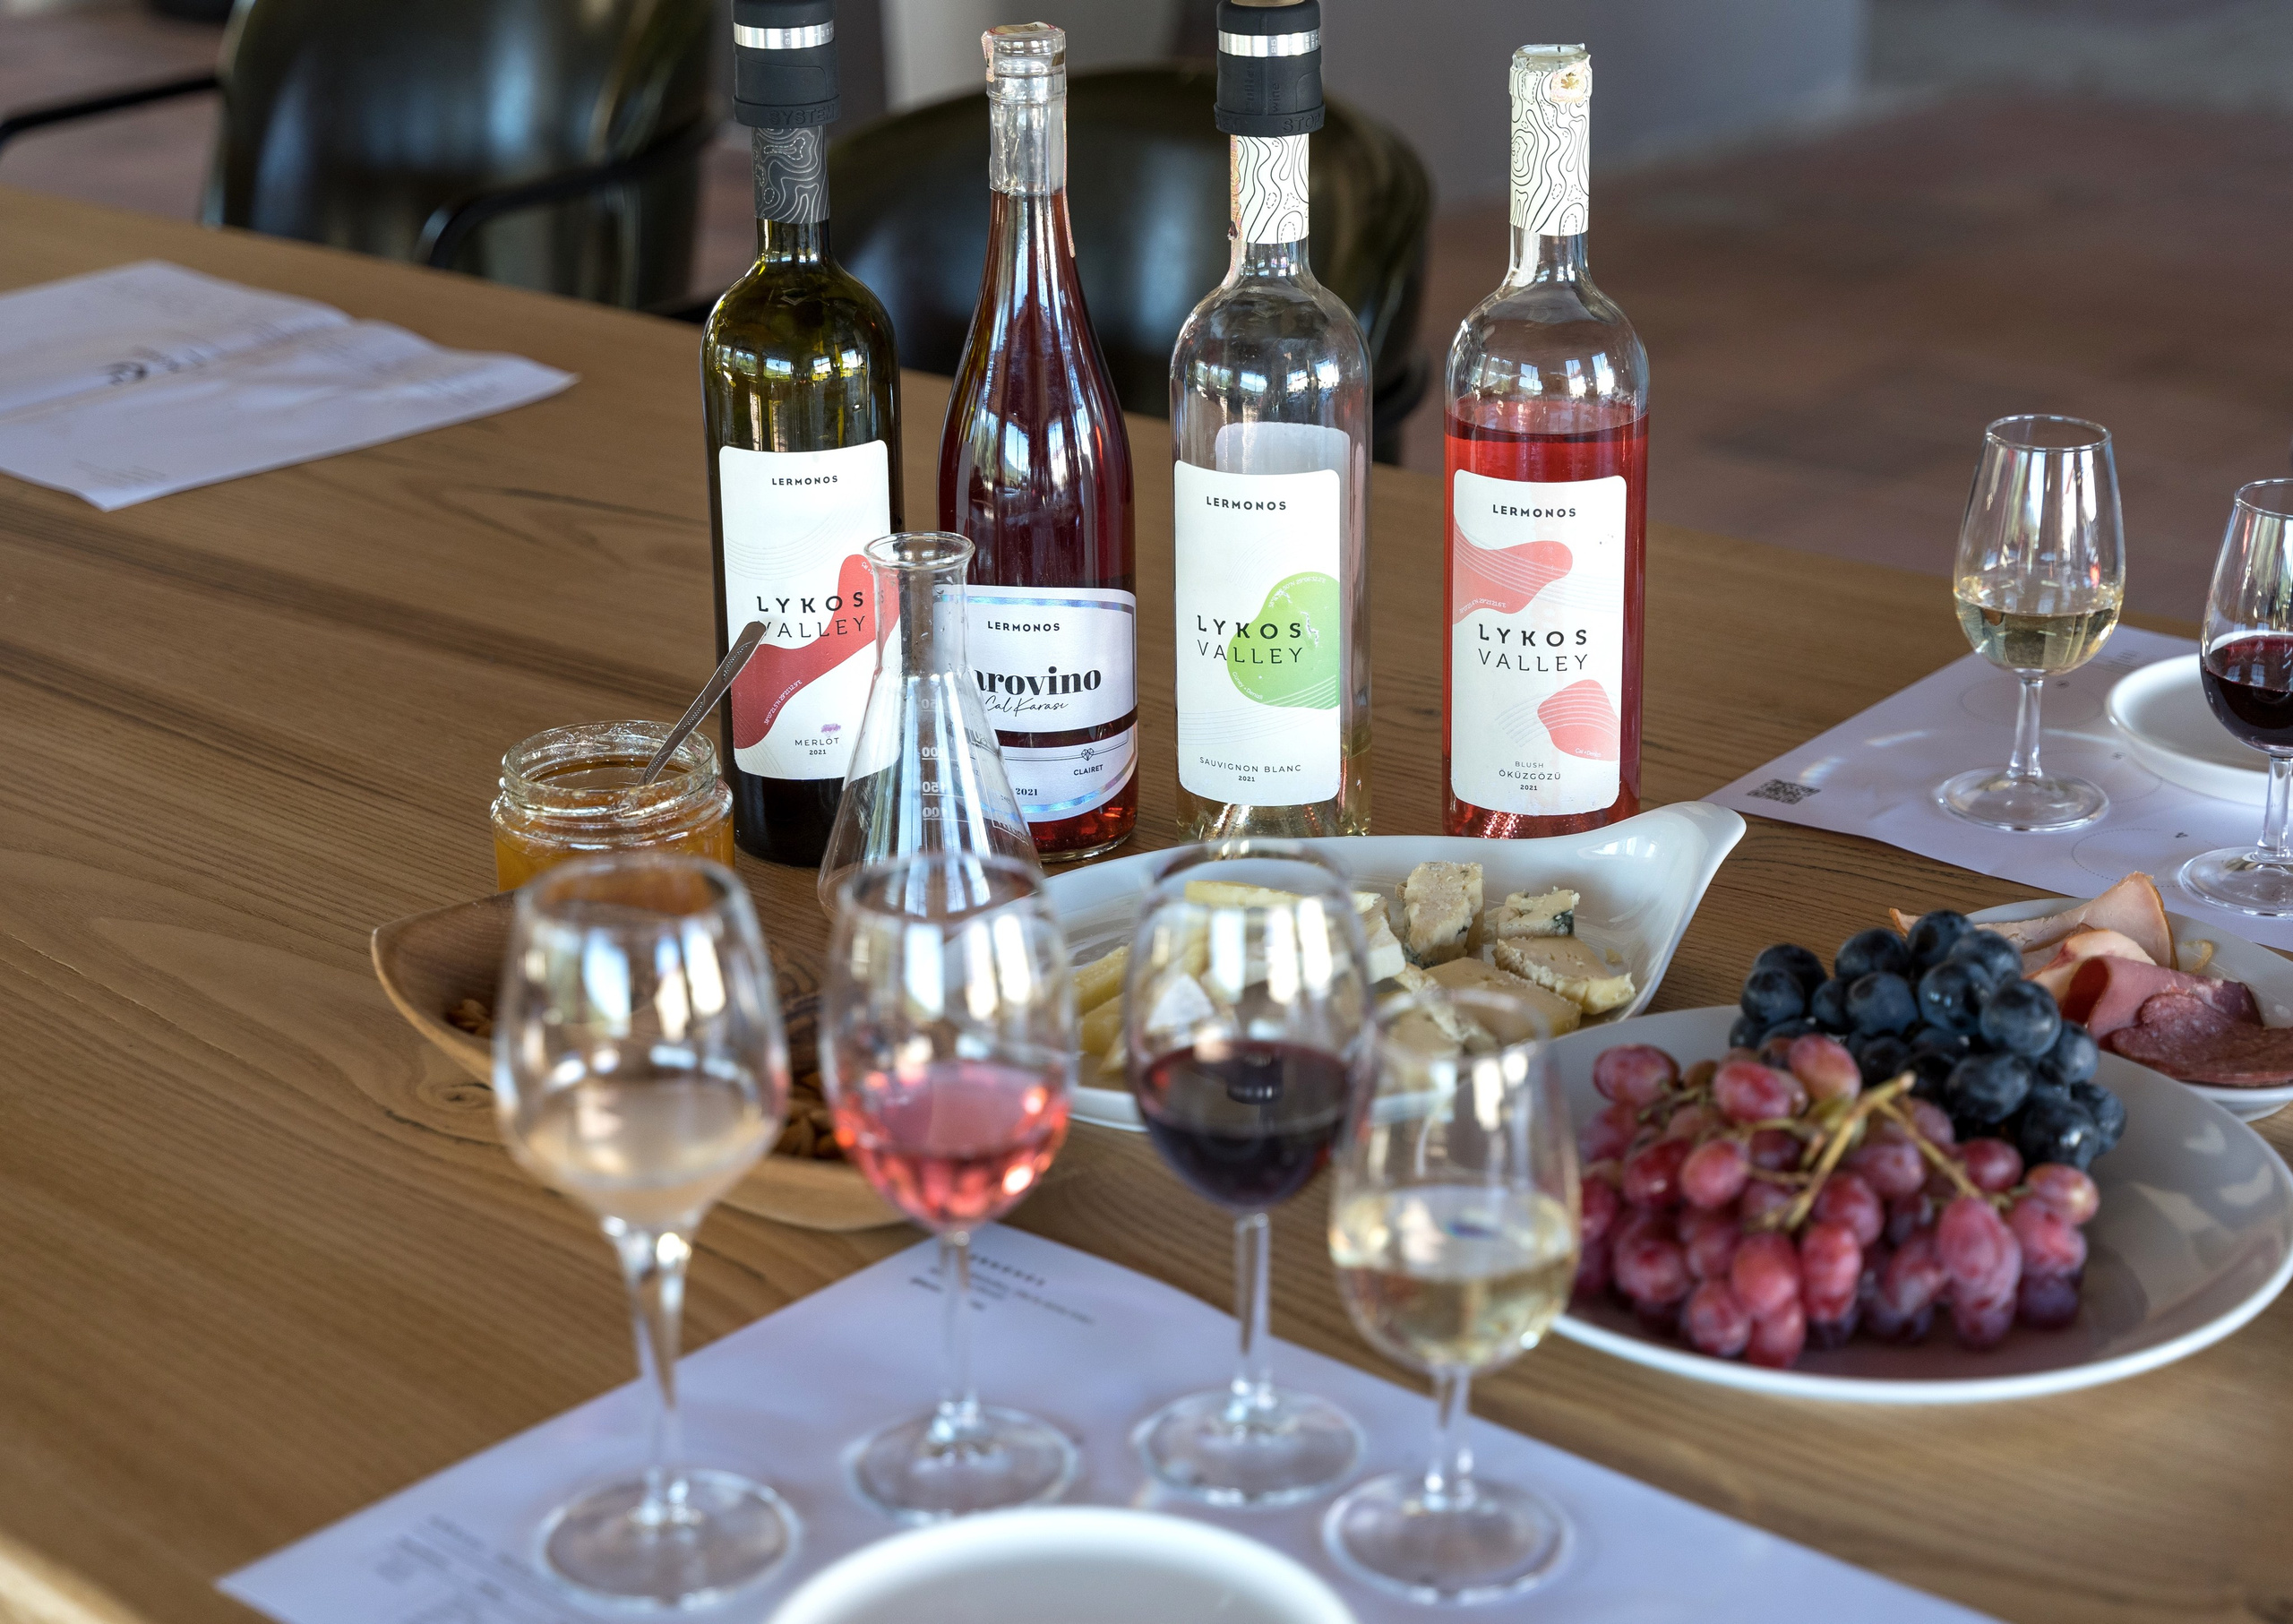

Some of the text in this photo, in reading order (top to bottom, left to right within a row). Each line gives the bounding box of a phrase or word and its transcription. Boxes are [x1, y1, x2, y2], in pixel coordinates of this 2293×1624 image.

[1269, 82, 1280, 112] wine
[769, 104, 836, 125] SYSTEM
[1282, 114, 1321, 133] STOP
[771, 475, 838, 485] LERMONOS
[1206, 495, 1287, 511] LERMONOS
[1492, 503, 1576, 518] LERMONOS
[756, 591, 864, 614] LYKOS
[987, 621, 1061, 632] LERMONOS
[1197, 614, 1301, 640] LYKOS
[1478, 623, 1587, 648] LYKOS
[1197, 639, 1303, 664] VALLEY
[1478, 648, 1588, 672] VALLEY
[794, 737, 839, 746] MERLOT
[1073, 764, 1104, 776] CLAIRET
[1199, 756, 1301, 773] SAUVIGNON BLANC
[1515, 760, 1544, 769] BLUSH
[1499, 768, 1561, 780] ÖKÜZGÖZÜ
[1015, 787, 1038, 796] 2021
